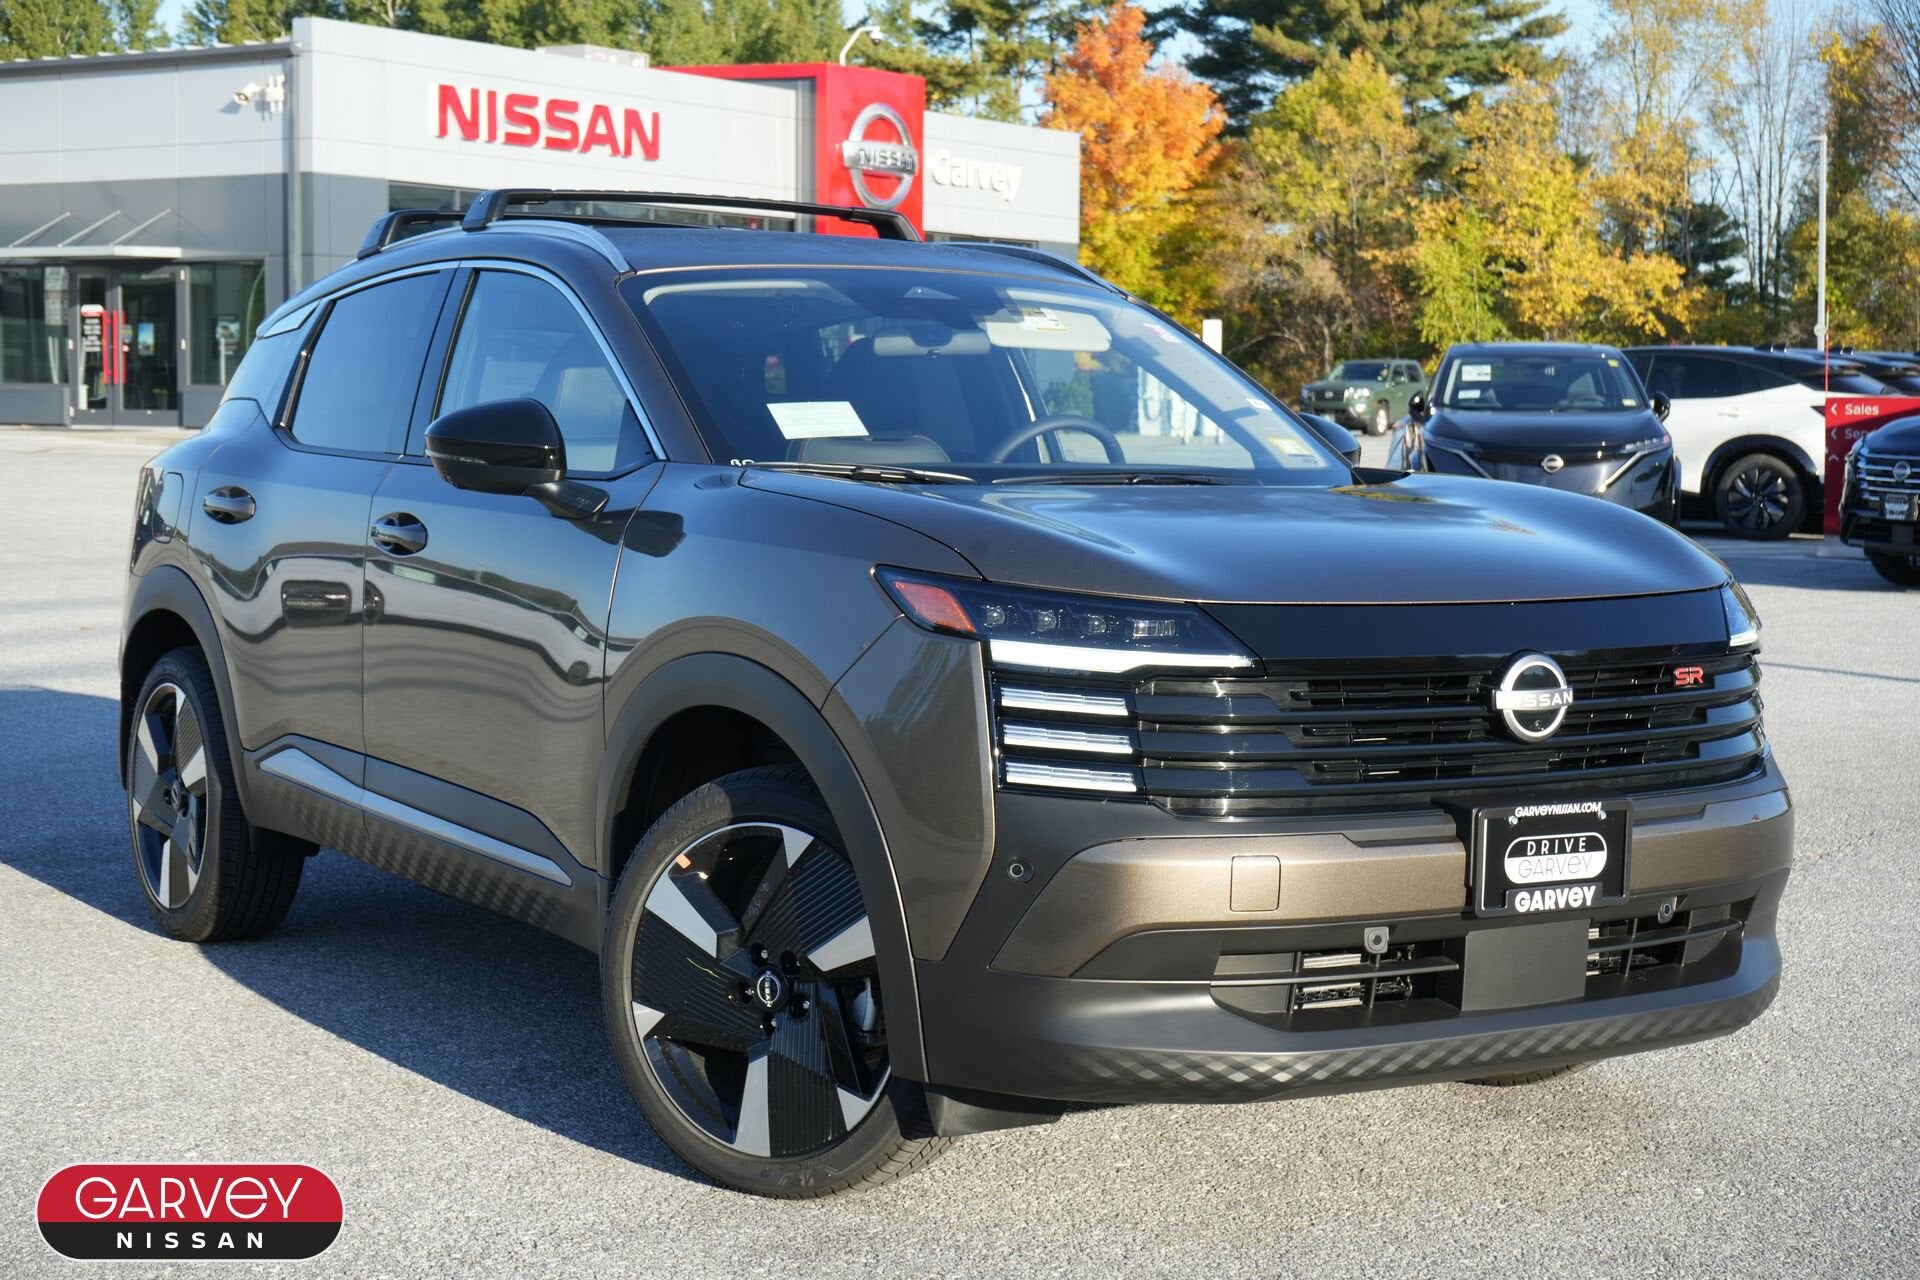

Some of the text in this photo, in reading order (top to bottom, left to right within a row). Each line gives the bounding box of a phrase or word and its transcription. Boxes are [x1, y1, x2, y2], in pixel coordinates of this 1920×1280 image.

[437, 84, 660, 161] NISSAN
[858, 148, 916, 171] NISSAN
[931, 149, 1023, 202] Garvey
[1844, 402, 1880, 416] Sales
[1674, 666, 1704, 686] SR
[1500, 690, 1574, 708] SSAN
[1527, 837, 1587, 856] DRIVE
